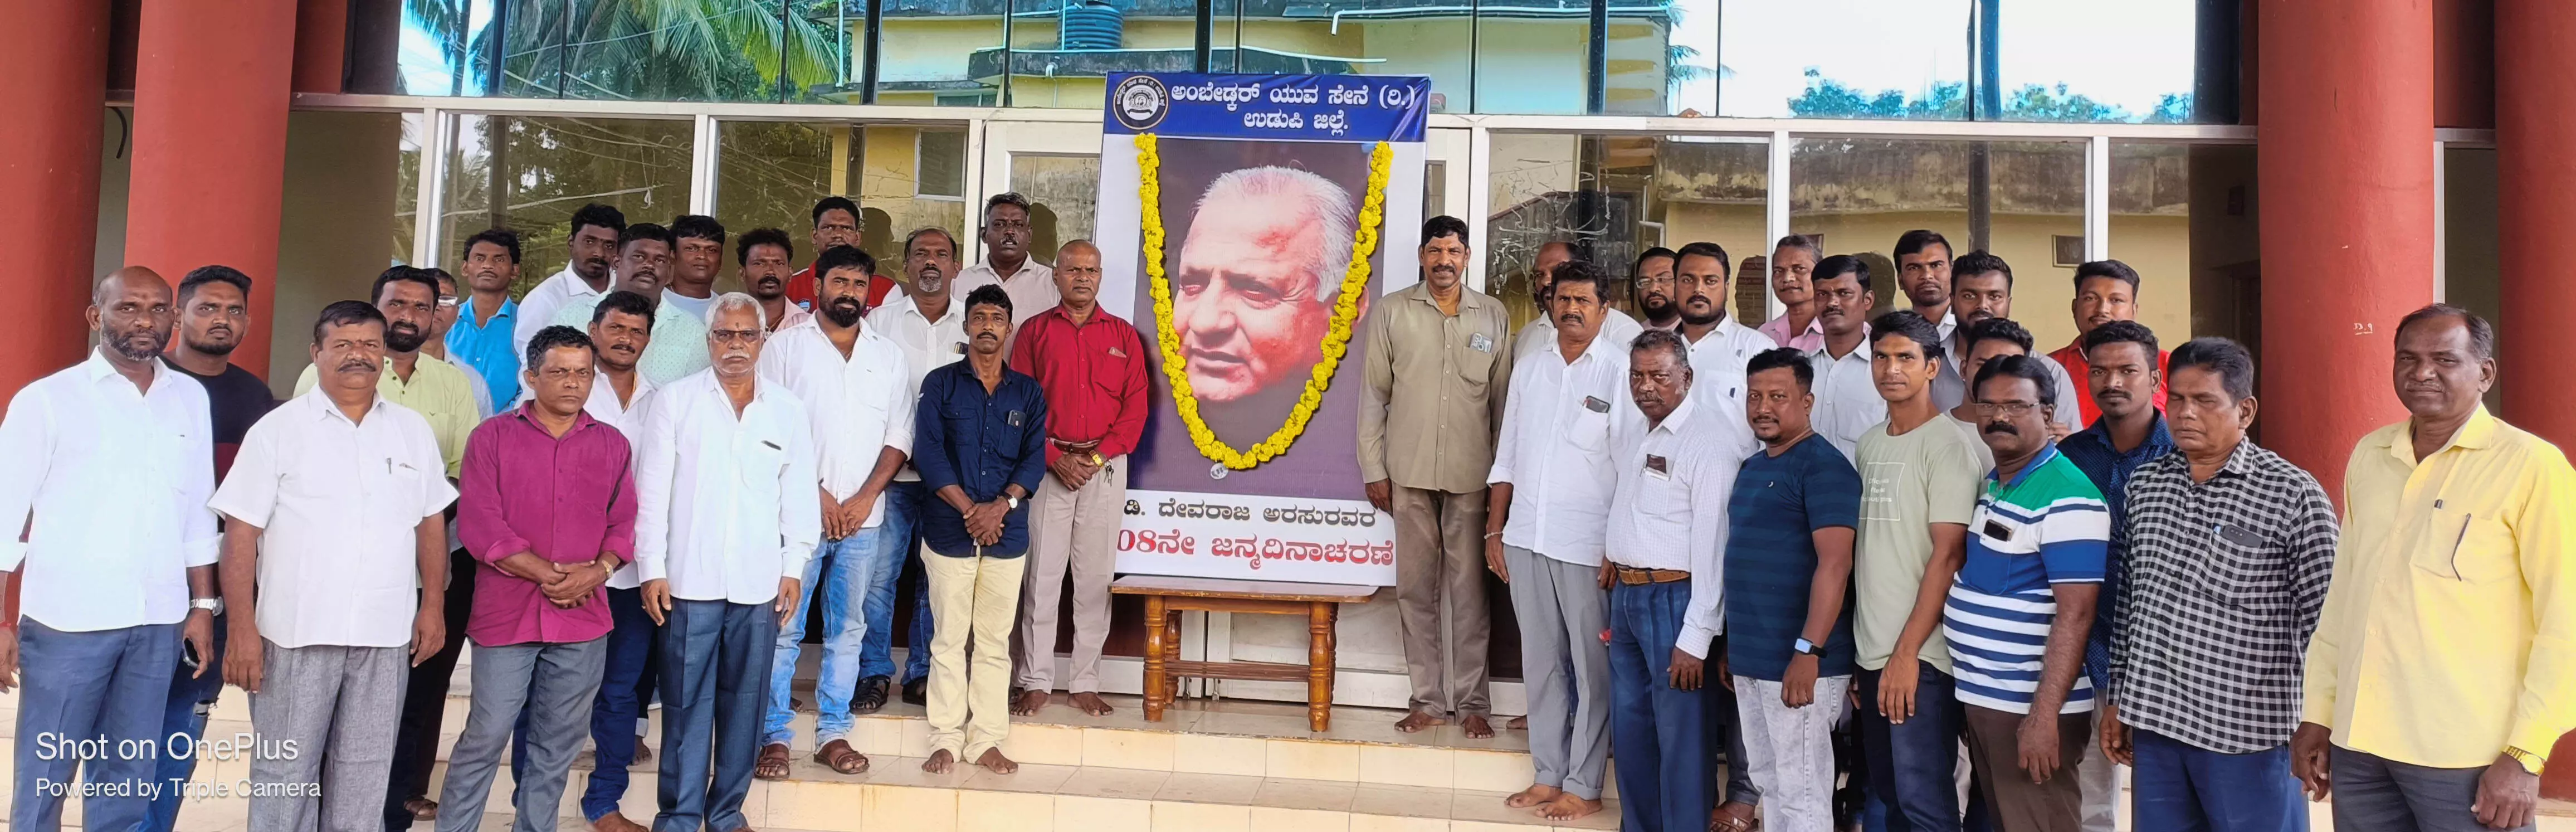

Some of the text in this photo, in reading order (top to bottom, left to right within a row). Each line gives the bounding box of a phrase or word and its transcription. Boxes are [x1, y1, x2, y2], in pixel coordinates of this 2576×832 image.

[1172, 82, 1260, 111] ಅಂಬೇಡ್ಕರ್
[1270, 84, 1318, 104] ಯುವ
[1328, 85, 1369, 105] ಸೇನೆ
[1379, 85, 1415, 109] (ರಿ.)
[1244, 109, 1349, 136] ಉಡುಪಿ ಜಿಲ್ಲೆ.
[1124, 498, 1377, 528] ಡಿ. ದೇವರಾಜ ಅರಸುರವರ
[1211, 533, 1394, 570] ಜನ್ಮದಿನಾಚರಣೆ
